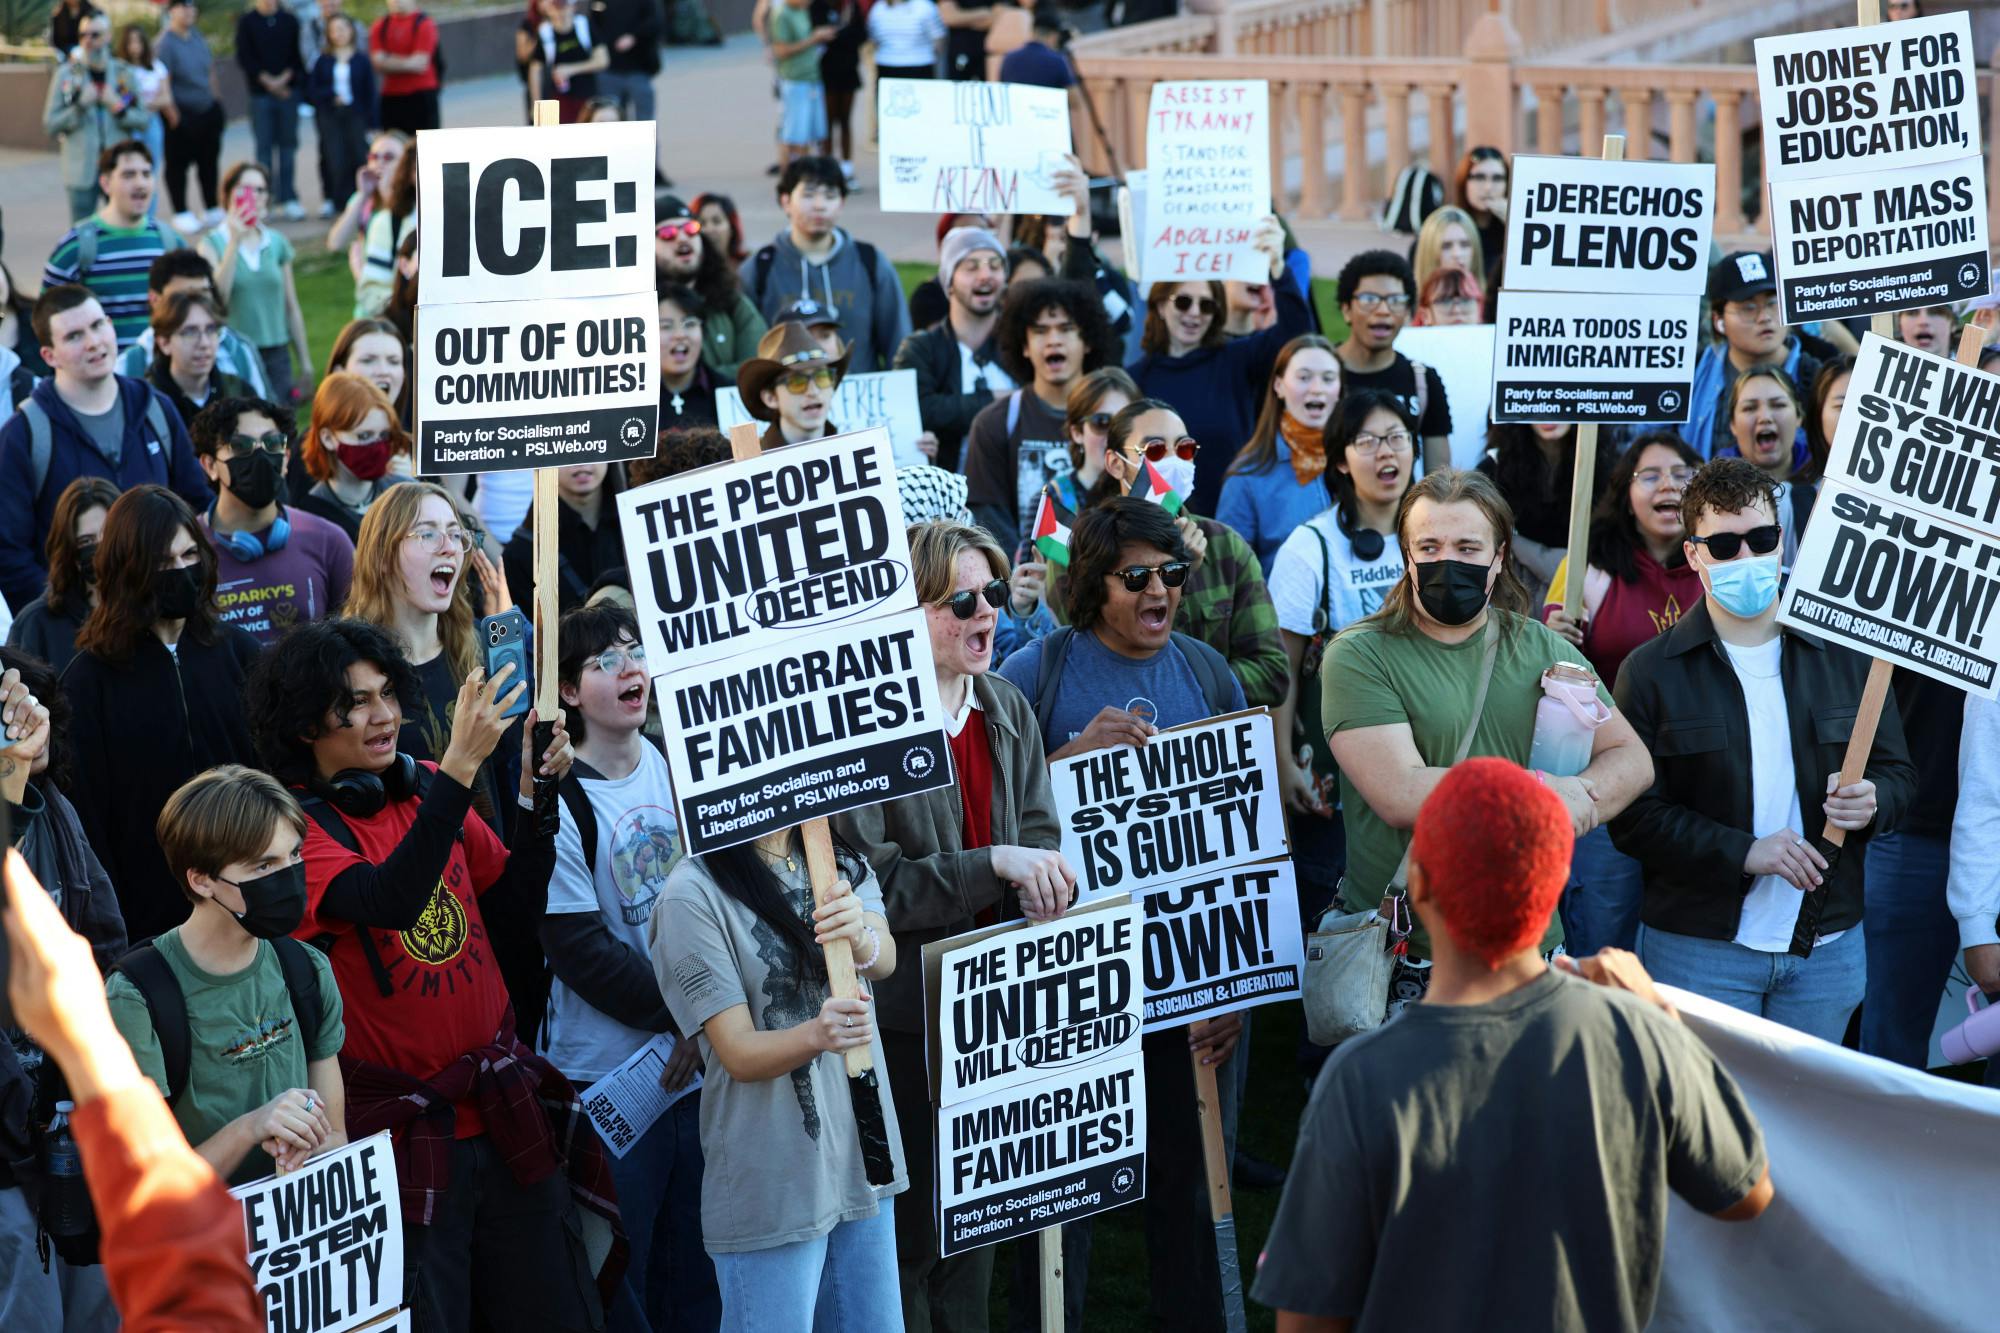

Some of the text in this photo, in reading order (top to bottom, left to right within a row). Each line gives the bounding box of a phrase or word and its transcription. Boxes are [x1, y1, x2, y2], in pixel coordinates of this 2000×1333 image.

[1773, 32, 1960, 86] MONEY FOR
[1155, 110, 1255, 133] TYRANNY
[1164, 87, 1247, 104] RESIST
[1776, 69, 1965, 129] JOBS AND
[1779, 111, 1968, 165] EDUCATION,
[442, 156, 637, 277] ICE:
[1525, 183, 1703, 218] ¡DERECHOS
[1790, 176, 1973, 234] NOT MASS
[1154, 226, 1250, 248] ABOLISH
[1173, 252, 1233, 274] ICE!
[1521, 223, 1698, 271] PLENOS
[1792, 216, 1976, 266] DEPORTATION!
[1794, 269, 1933, 298] Party for Socialism and
[1796, 284, 1949, 313] Liberation PSLWeb.org
[435, 317, 647, 366] OUT OF OUR
[1508, 317, 1688, 339] PARA TODOS LOS
[1506, 344, 1685, 368] INMIGRANTES!
[1873, 344, 1940, 410] THE
[435, 362, 646, 405] COMMUNITIES!
[1504, 388, 1634, 401] Party for Socialism and
[1504, 402, 1647, 416] Liberation PSLWeb.org
[434, 420, 590, 446] Party for Socialism and
[434, 439, 607, 462] Liberation PSLWeb.org
[1846, 421, 1893, 484] IS
[635, 446, 882, 544] THE PEOPLE
[647, 495, 889, 614] UNITED
[1831, 492, 2000, 576] SHUT I
[217, 584, 295, 607] SPARKY'S
[247, 605, 264, 617] OF
[657, 560, 897, 654] WILL DEFEND
[1818, 524, 2000, 650] DOWN!
[237, 620, 271, 632] VICE
[1793, 595, 1992, 682] PARTY FOR SOCIALISM & LIBERATION
[675, 630, 914, 730] IMMIGRANT
[684, 676, 925, 783] FAMILIES!
[696, 758, 866, 820] Party for Socialism and
[1069, 723, 1257, 807] THE WHOLE
[700, 775, 890, 839] Liberation PSLWeb.org
[1070, 770, 1264, 833] SYSTEM
[1080, 795, 1260, 891] IS GUILTY
[1232, 869, 1279, 898] IT
[953, 917, 1132, 994] THE PEOPLE
[953, 958, 1131, 1055] UNITED
[1156, 987, 1214, 1016] SOCIALISM
[1215, 985, 1229, 1001] &
[1230, 971, 1294, 997] LIBERATION
[954, 1014, 1131, 1088] WILL DEFEND
[585, 1100, 615, 1134] ABRAS
[593, 1092, 636, 1143] PARA ICE!
[952, 1068, 1135, 1150] IMMIGRANT
[953, 1108, 1134, 1196] FAMILIES!
[272, 1145, 382, 1243] WHOLE
[953, 1178, 1086, 1226] Party for Socialism and
[953, 1192, 1101, 1242] Liberation PSLWeb.org
[259, 1237, 384, 1333] GUILTY
